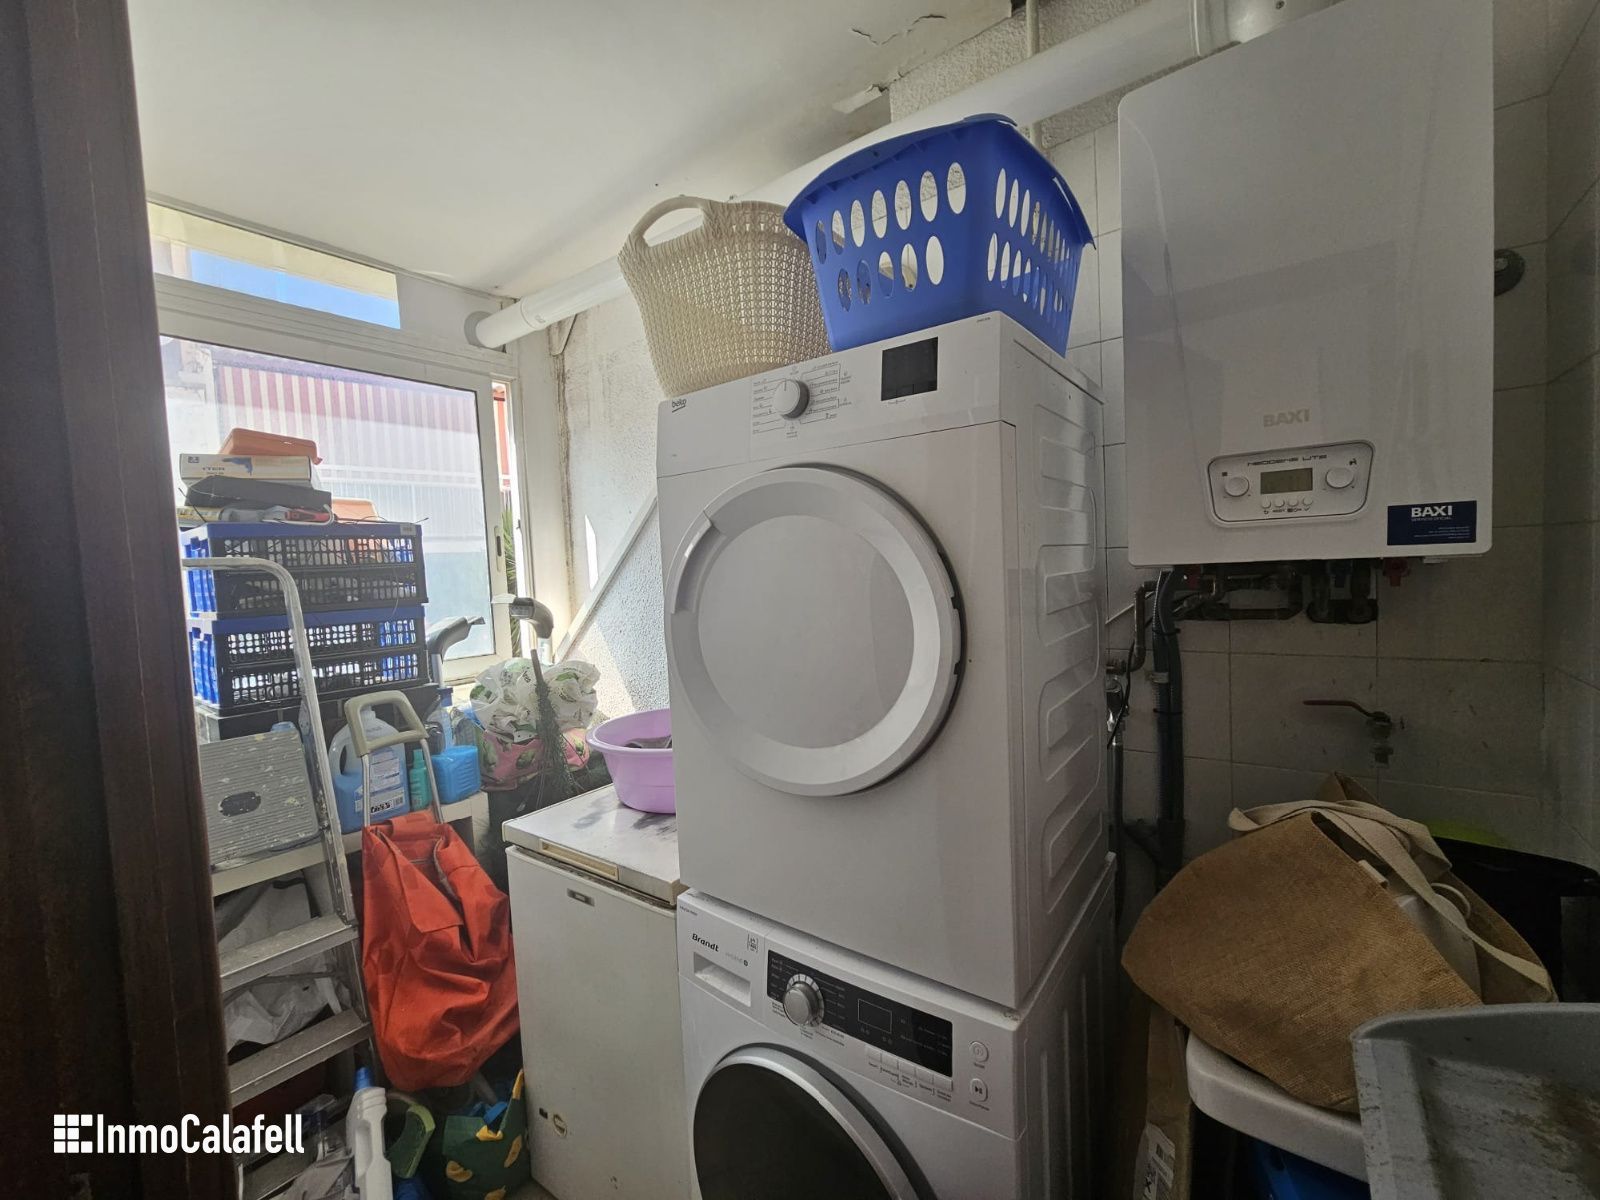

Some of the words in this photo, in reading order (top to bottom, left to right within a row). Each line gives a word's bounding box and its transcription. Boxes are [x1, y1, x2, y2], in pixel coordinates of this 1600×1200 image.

[1263, 408, 1310, 428] BAXI
[1411, 505, 1453, 518] BAXI
[691, 933, 720, 952] Brandt
